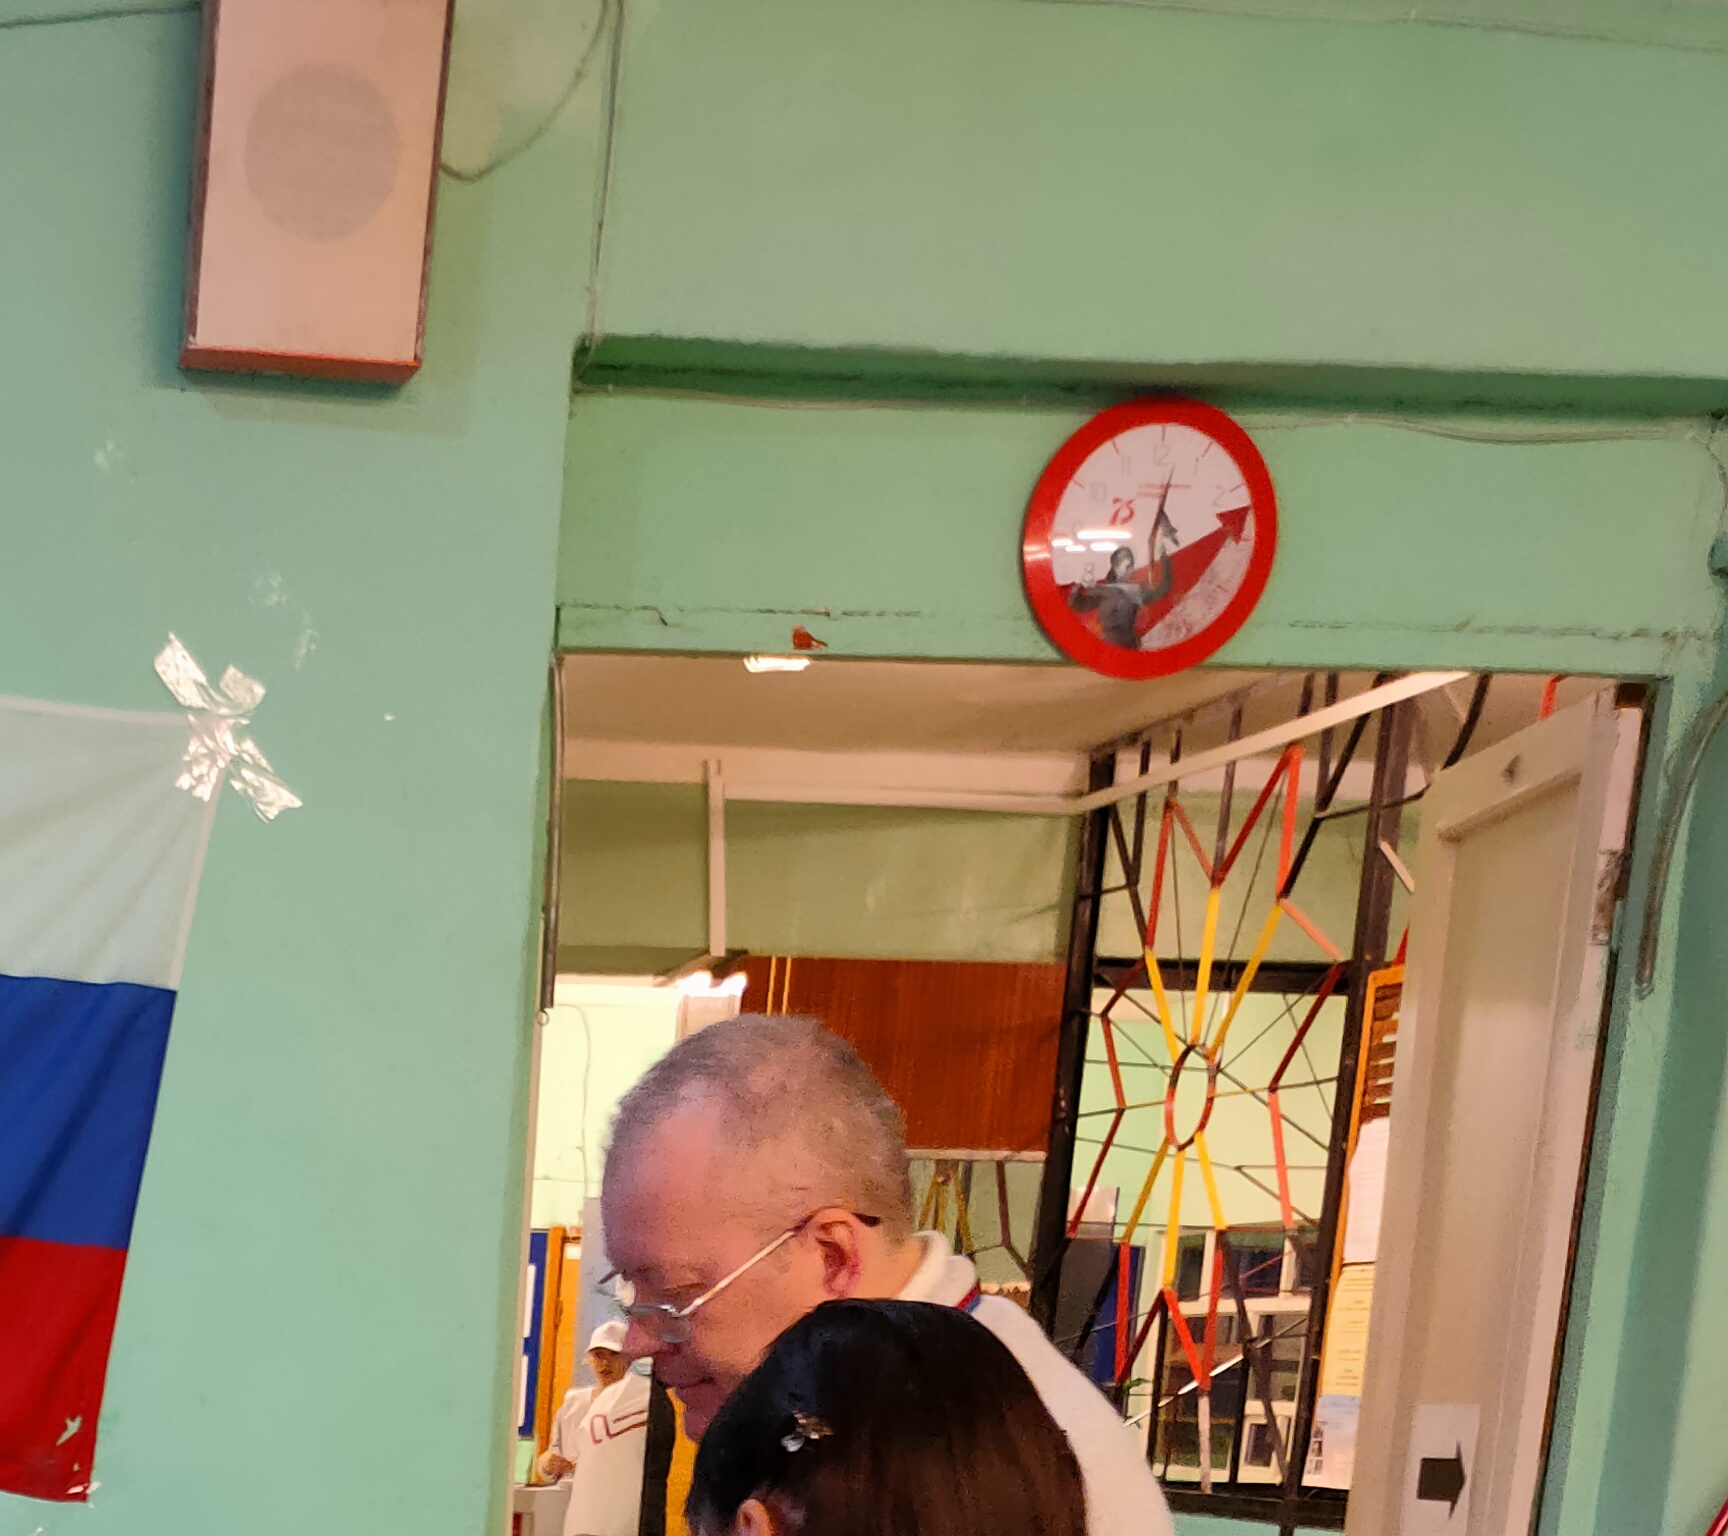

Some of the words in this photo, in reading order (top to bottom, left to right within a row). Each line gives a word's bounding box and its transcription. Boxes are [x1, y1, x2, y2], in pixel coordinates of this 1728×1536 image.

[1121, 456, 1132, 476] 11
[1153, 444, 1170, 466] 12
[1089, 482, 1107, 504] 10
[1211, 484, 1226, 507] 2
